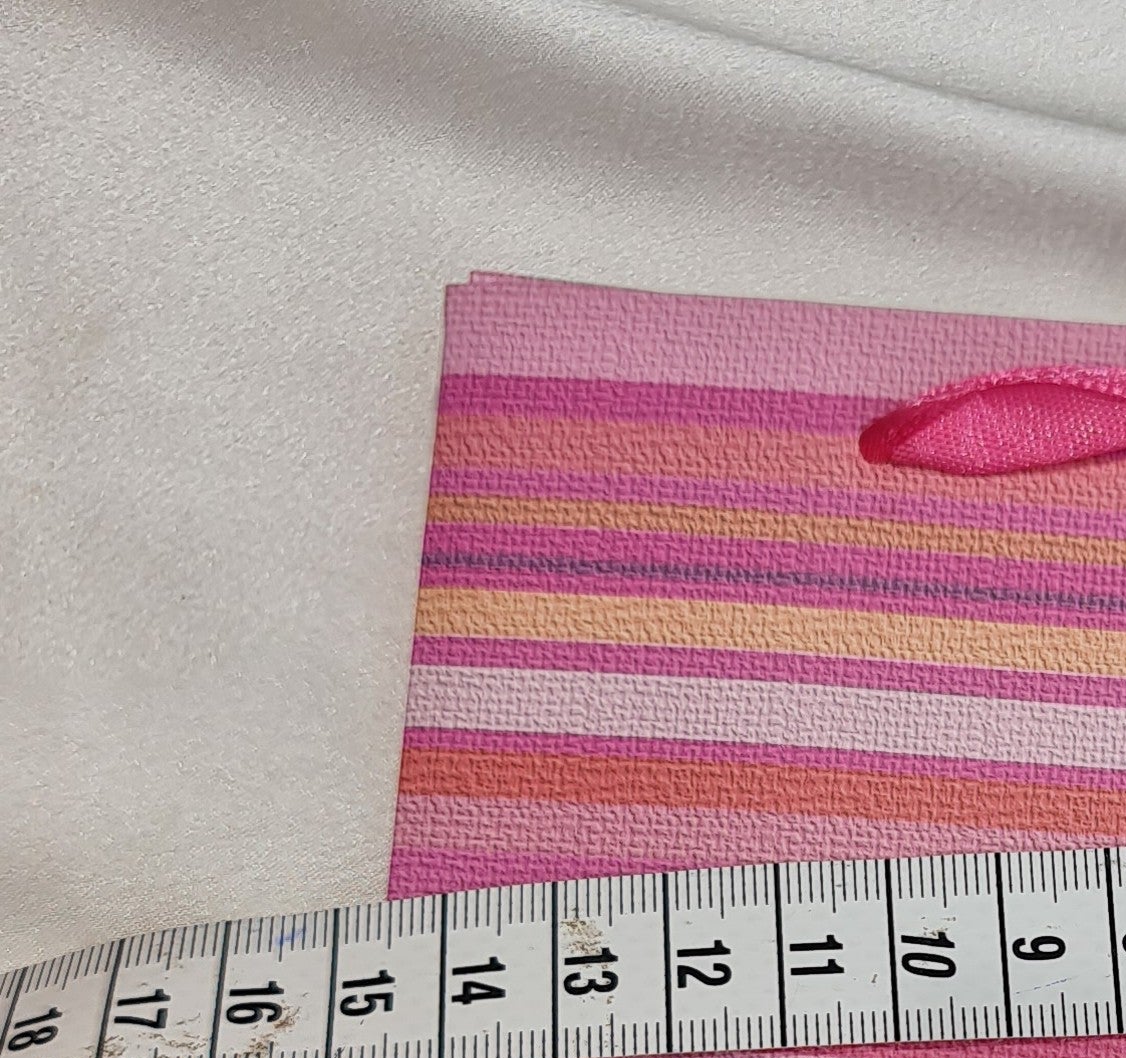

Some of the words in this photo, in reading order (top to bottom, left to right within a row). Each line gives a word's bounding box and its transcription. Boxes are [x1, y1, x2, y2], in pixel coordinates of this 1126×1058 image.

[676, 939, 732, 989] 12
[789, 934, 845, 976] 11
[900, 931, 957, 978] 10
[1012, 935, 1066, 961] 9
[339, 969, 395, 1017] 15
[451, 956, 506, 1005] 14
[563, 947, 619, 996] 13
[113, 989, 170, 1029] 17
[225, 981, 284, 1025] 16
[7, 1007, 62, 1052] 18
